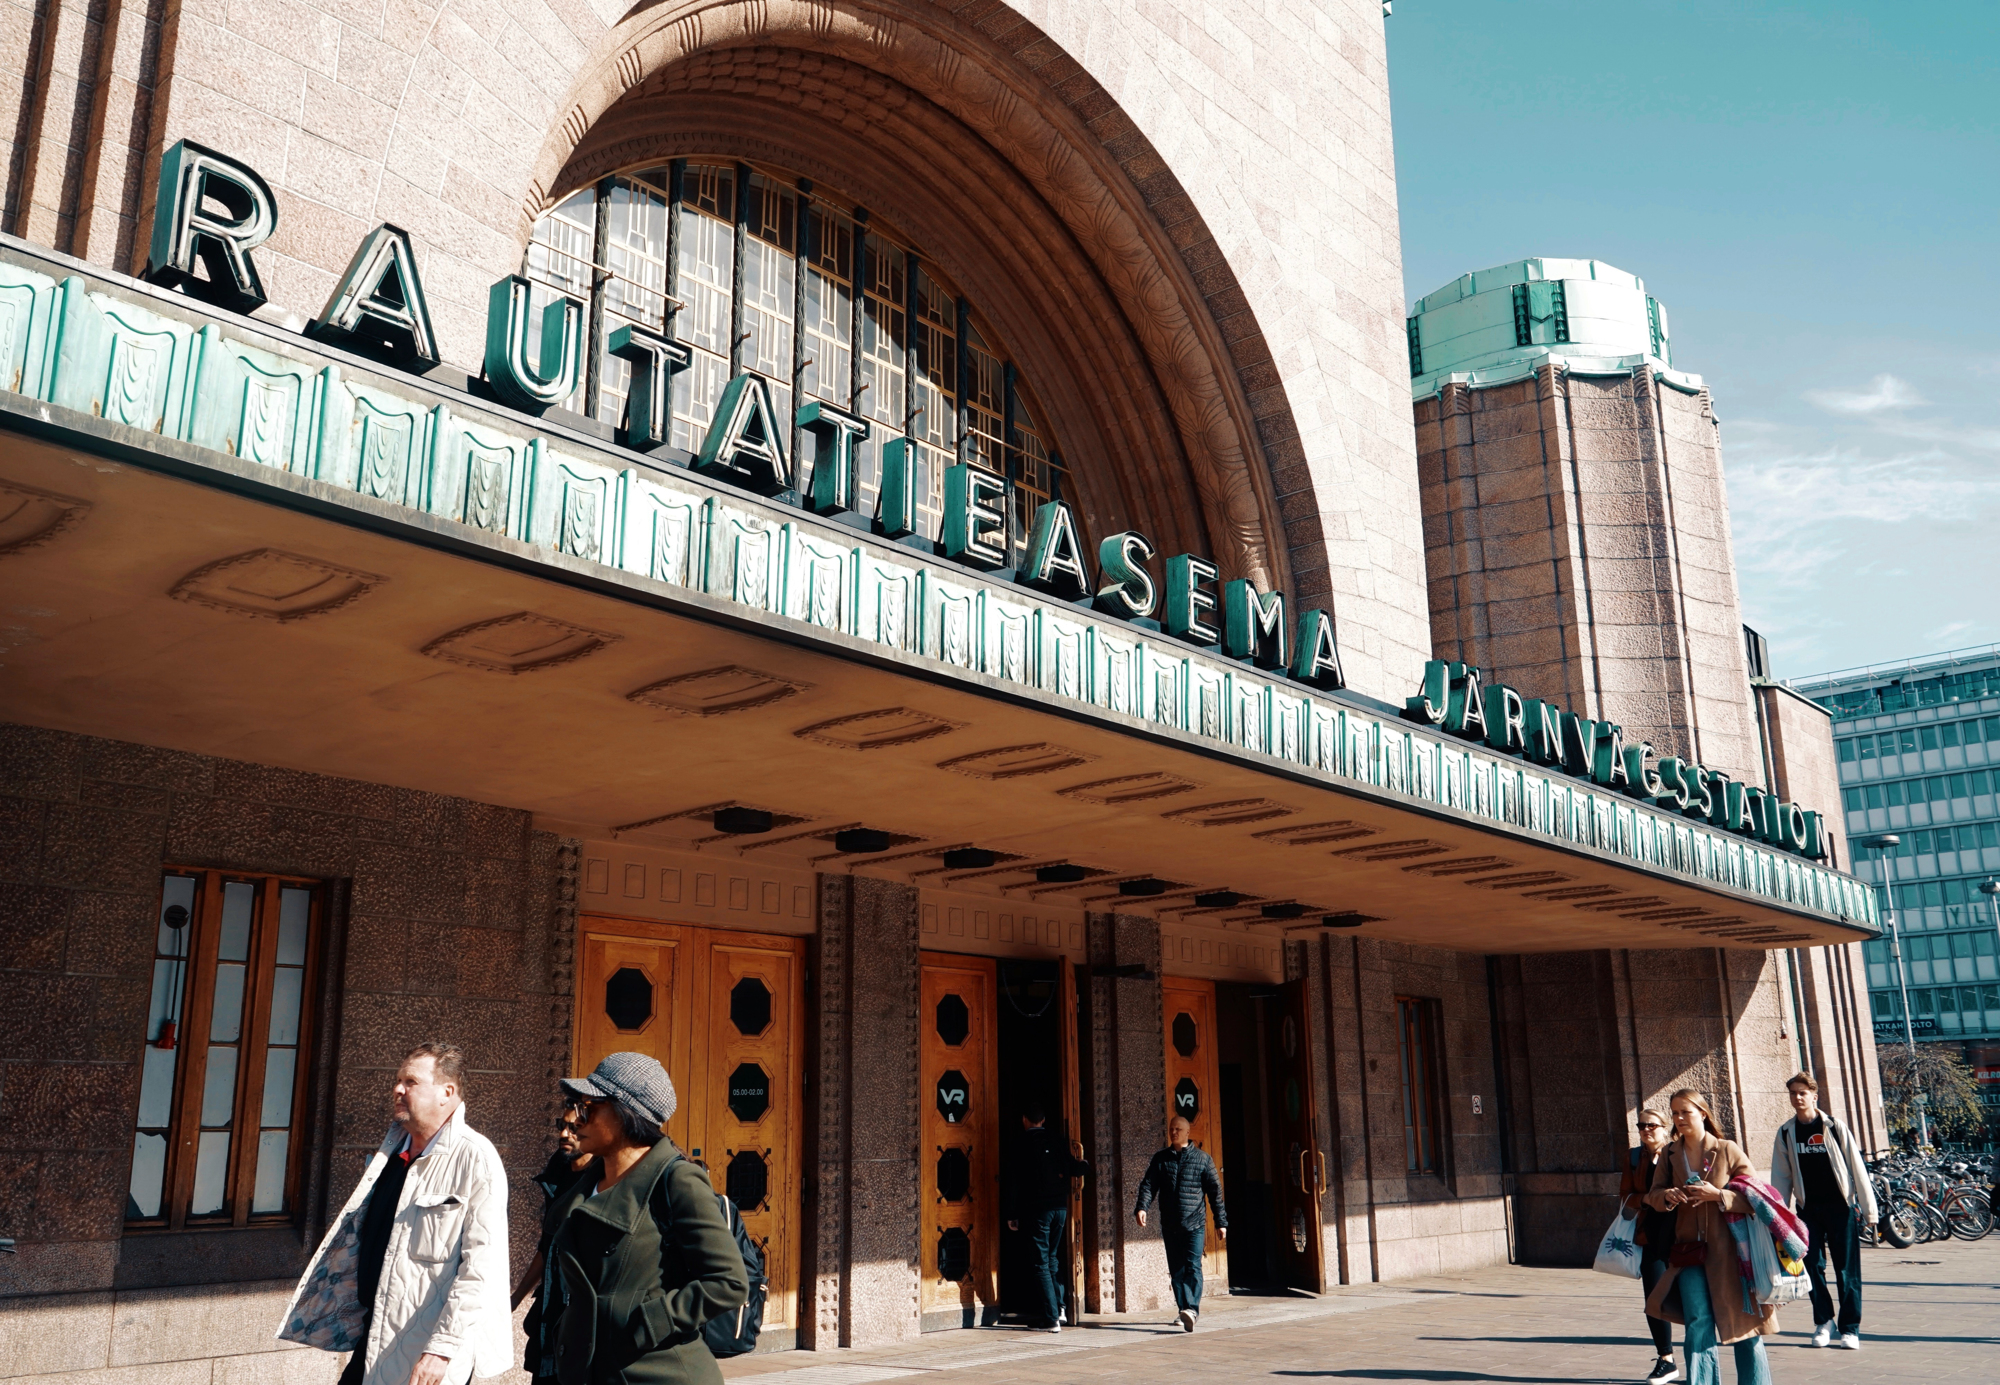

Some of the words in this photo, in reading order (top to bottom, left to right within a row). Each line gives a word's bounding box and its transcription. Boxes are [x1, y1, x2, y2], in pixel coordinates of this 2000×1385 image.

[144, 137, 1346, 690] RAUTATIEASEMA
[1402, 659, 1828, 859] JÄRNVÄGSSTATION
[1873, 1020, 1933, 1031] ATKAHOLTO
[732, 1088, 764, 1096] 05.00-02.00
[939, 1088, 965, 1105] VR
[1176, 1093, 1195, 1107] VR
